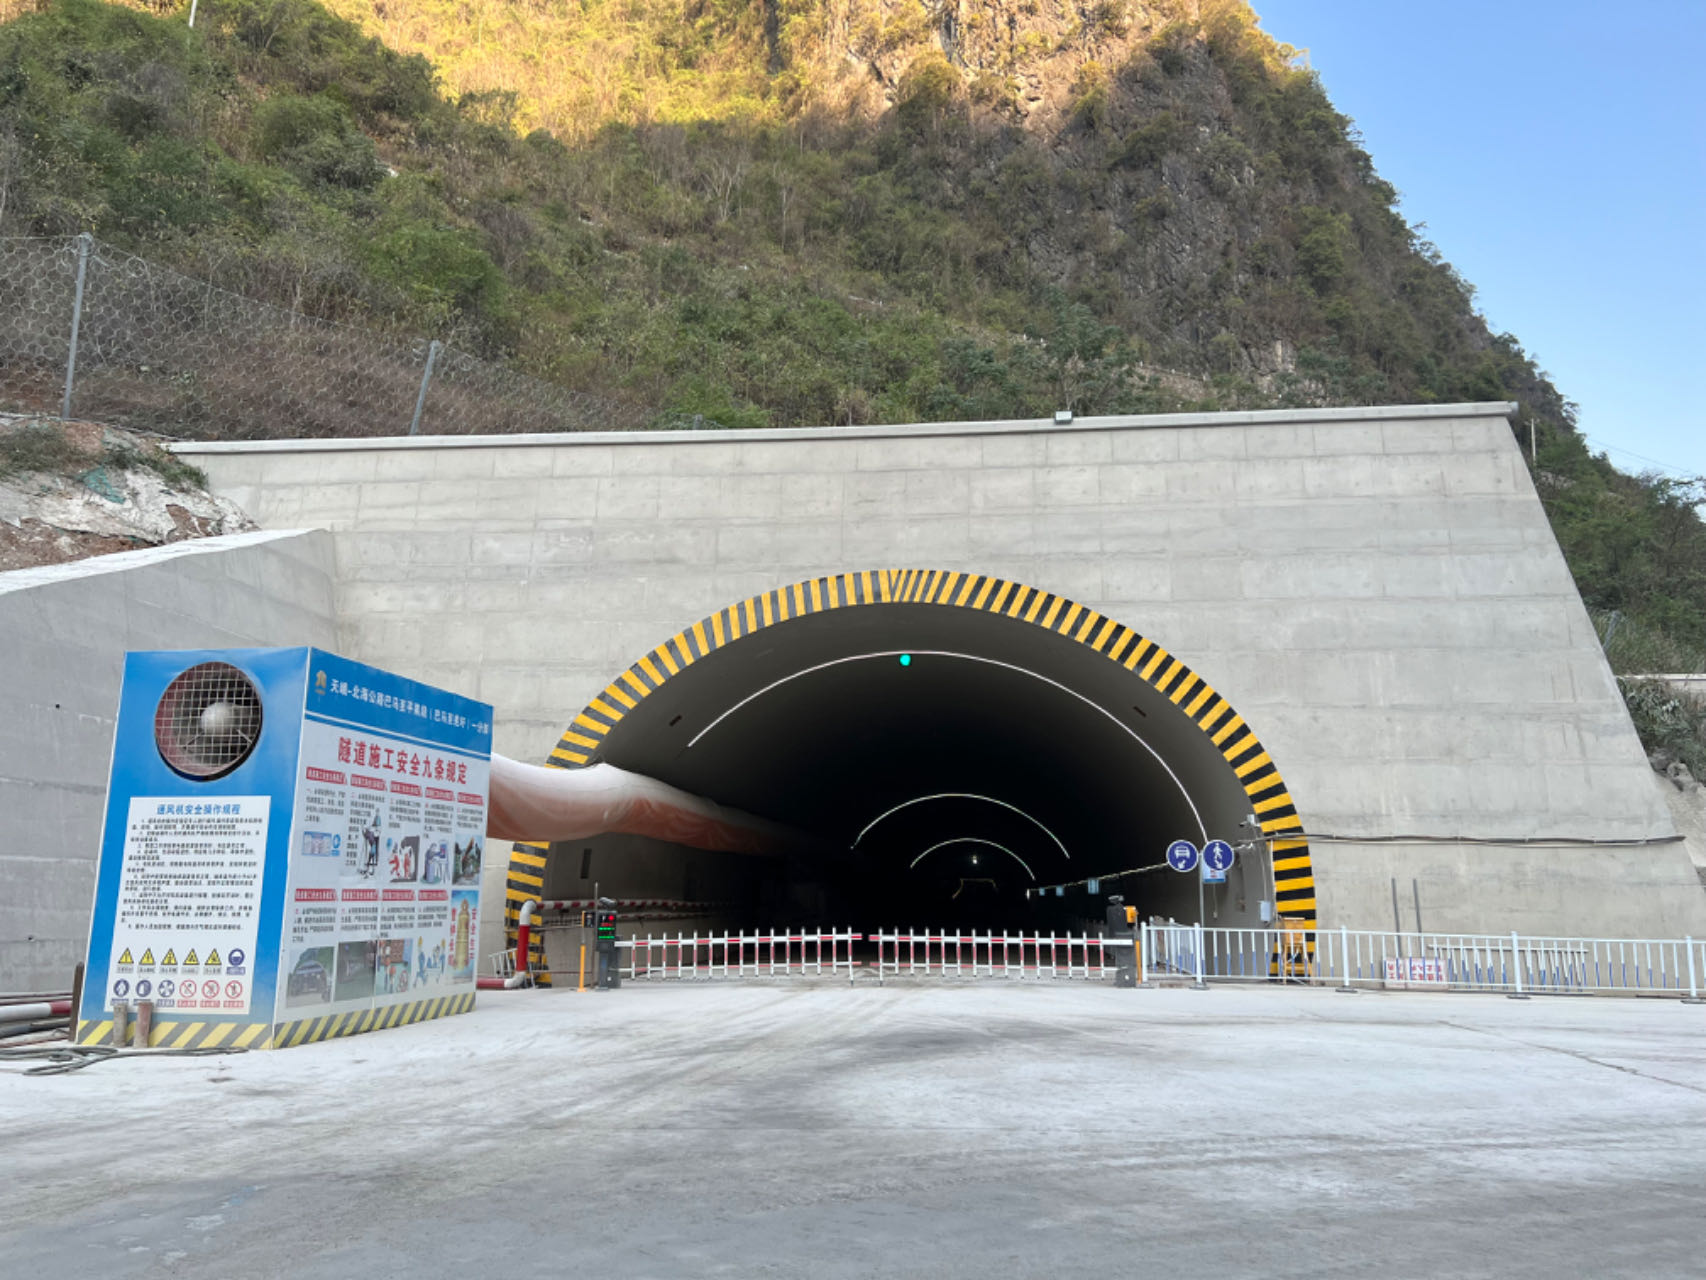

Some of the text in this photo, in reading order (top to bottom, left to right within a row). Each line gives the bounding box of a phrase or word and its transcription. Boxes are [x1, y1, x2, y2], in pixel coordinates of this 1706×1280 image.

[337, 736, 468, 785] 隧道施工安全九条规定
